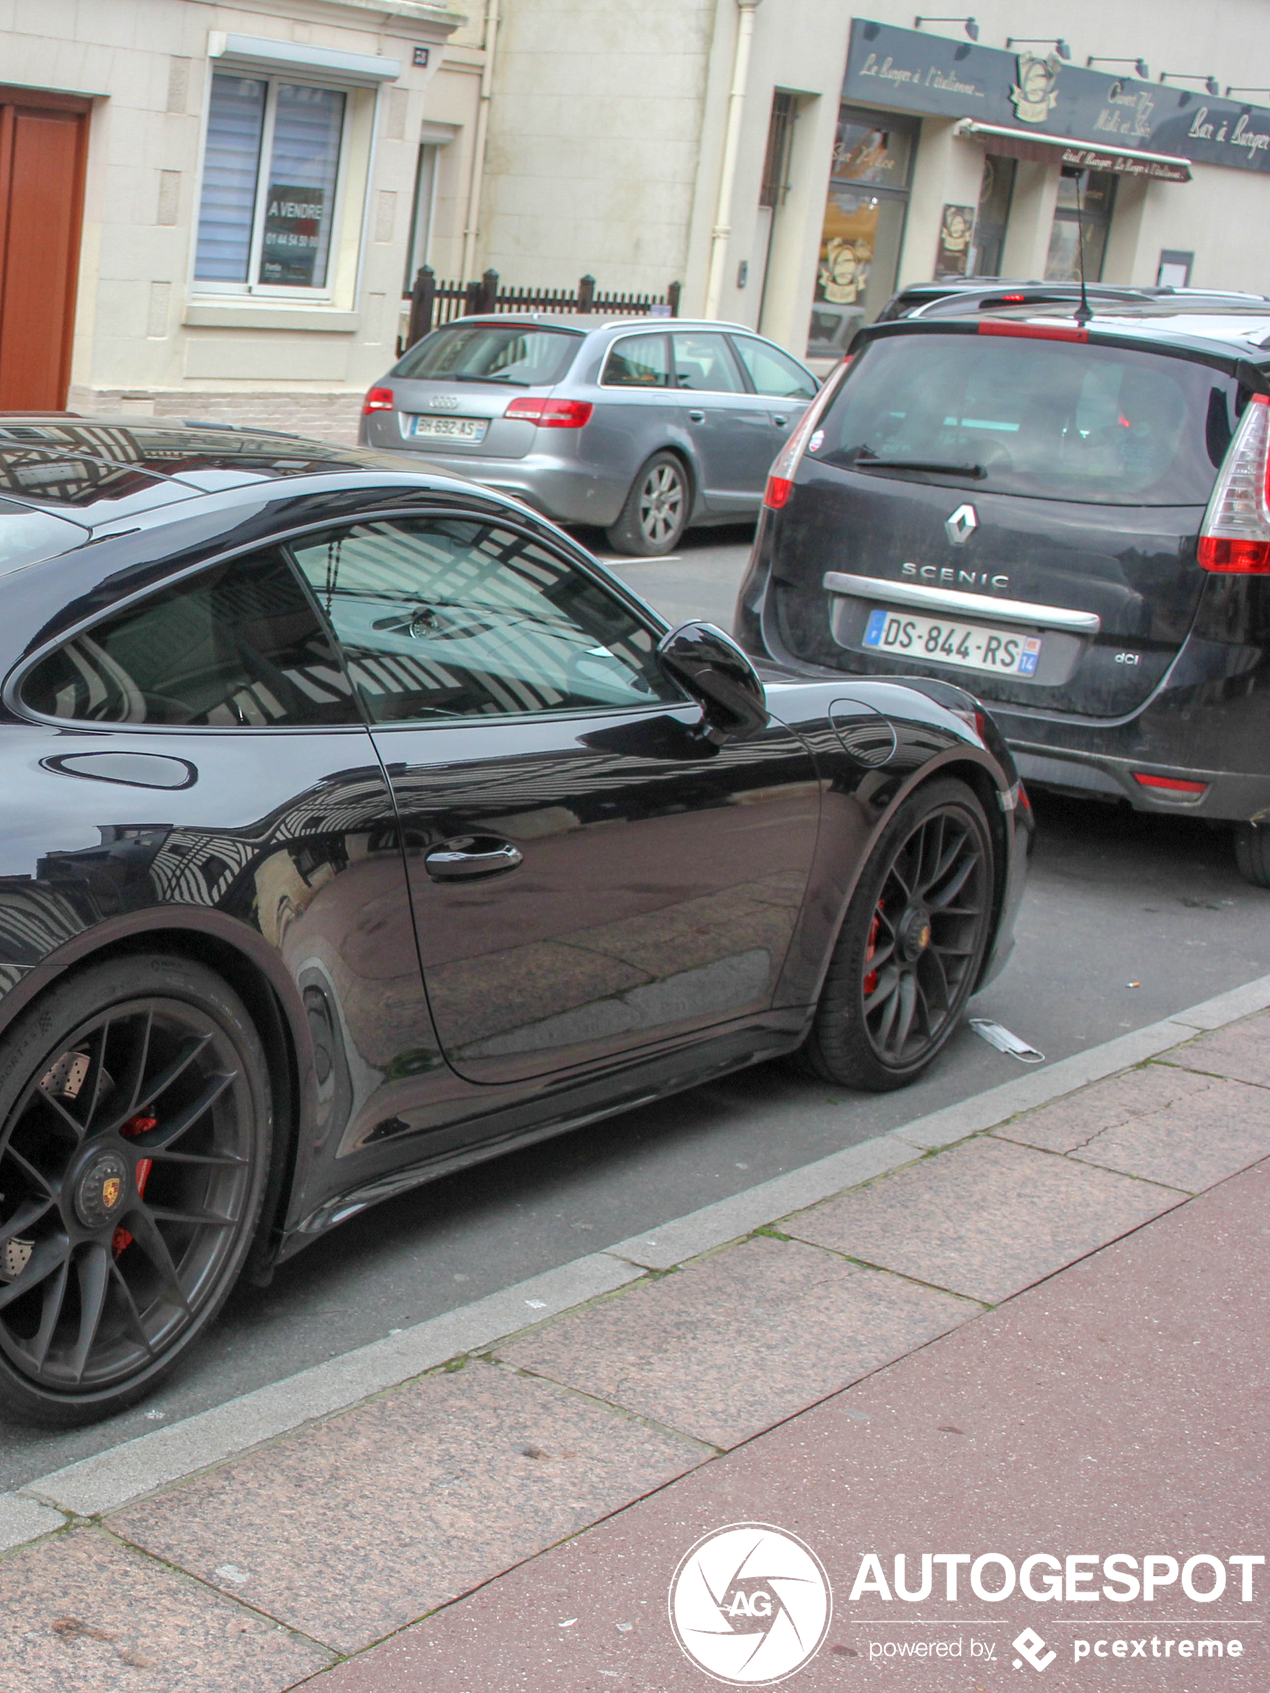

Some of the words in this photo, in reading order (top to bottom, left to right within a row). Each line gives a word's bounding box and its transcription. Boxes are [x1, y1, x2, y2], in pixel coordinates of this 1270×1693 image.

[859, 53, 878, 75] Le
[879, 57, 911, 88] Burger
[1108, 81, 1137, 107] Ouvert
[1092, 109, 1120, 132] Midi
[1120, 120, 1131, 134] et
[1188, 107, 1214, 140] Bar
[1230, 114, 1270, 159] Burger
[268, 201, 279, 216] A
[280, 202, 323, 219] VENDRE
[902, 562, 1010, 588] SCENIC
[884, 618, 1020, 667] DS-844-RS
[1021, 655, 1034, 671] 14
